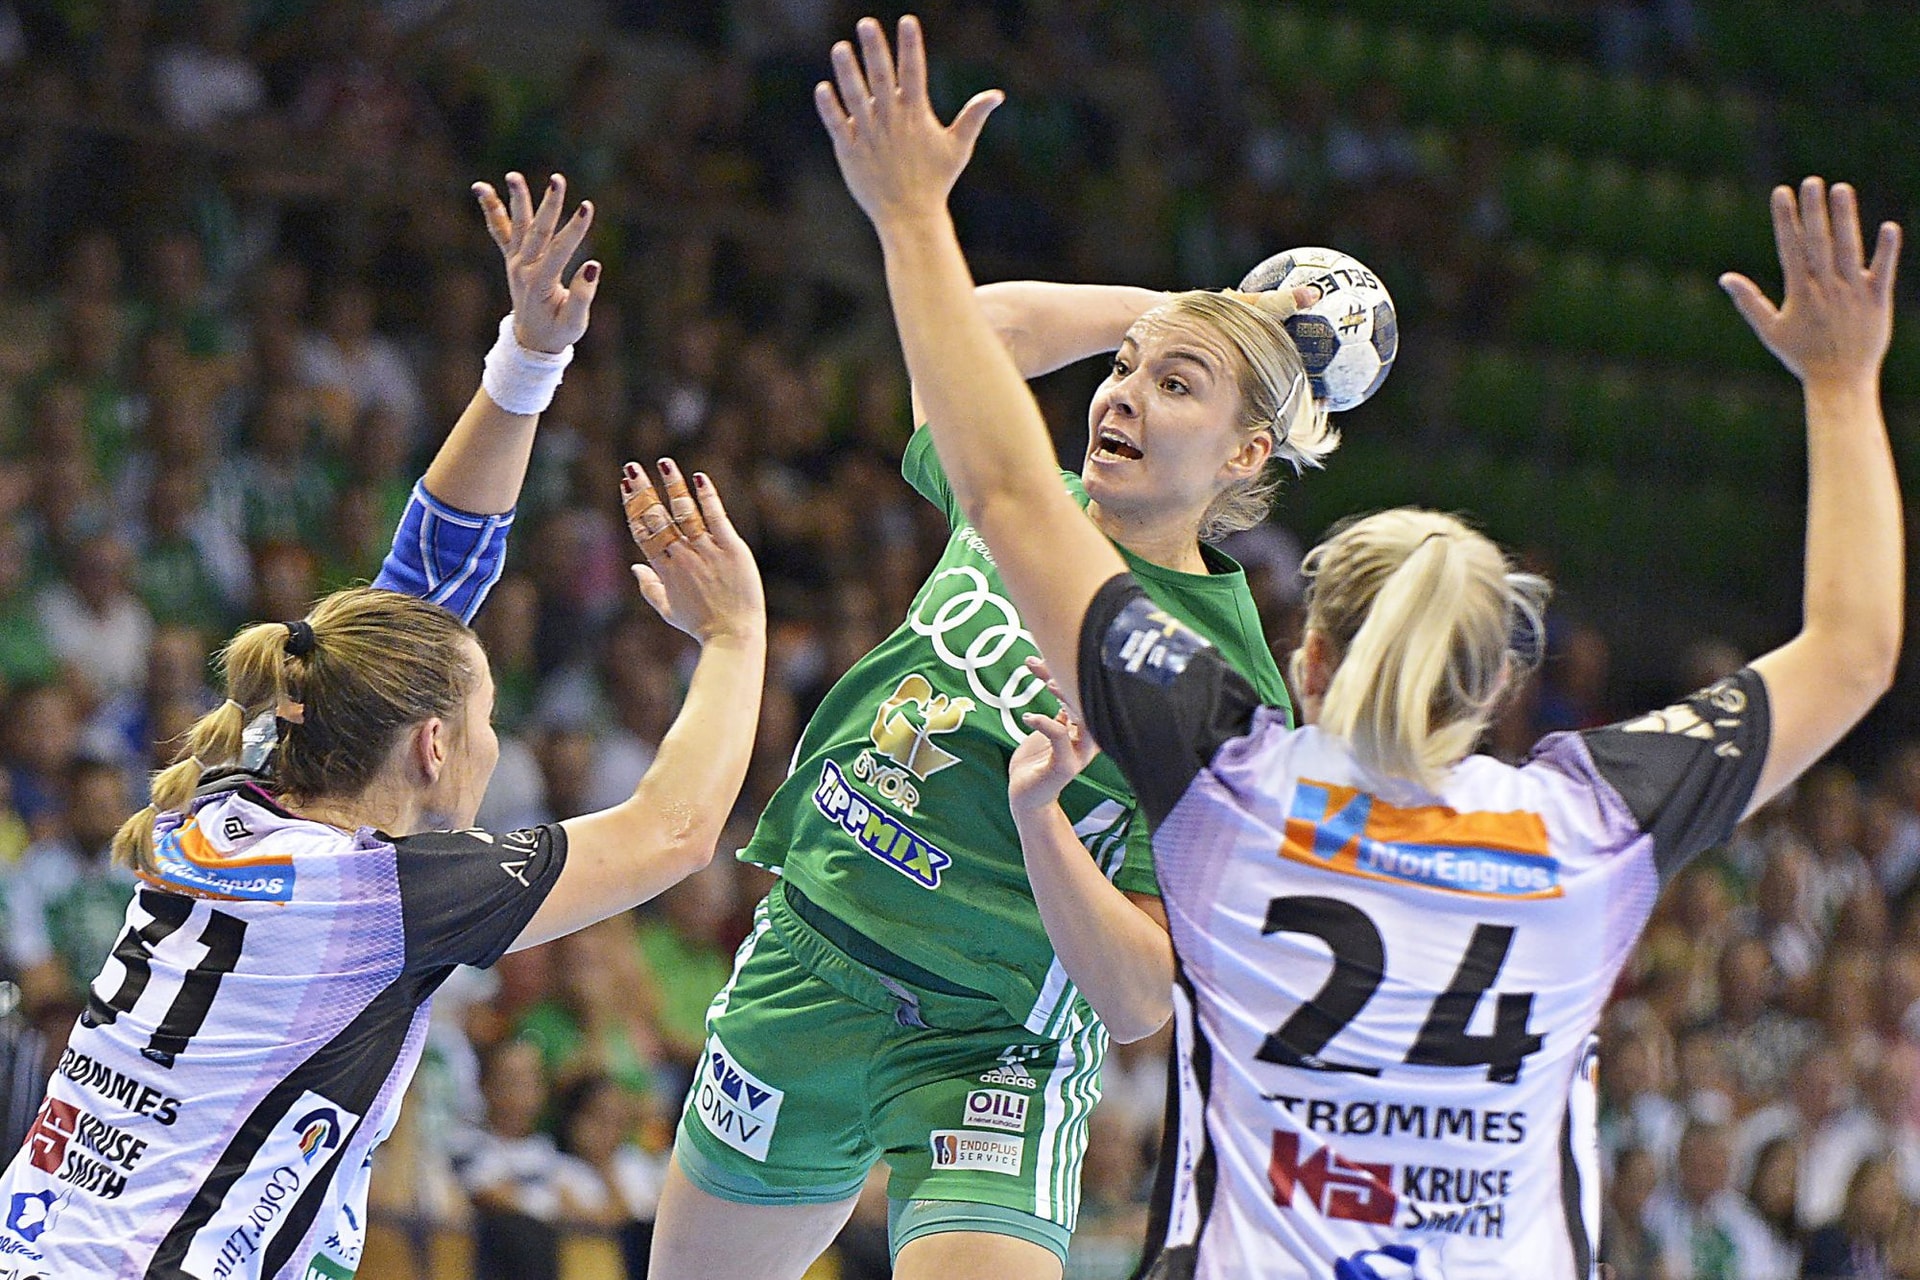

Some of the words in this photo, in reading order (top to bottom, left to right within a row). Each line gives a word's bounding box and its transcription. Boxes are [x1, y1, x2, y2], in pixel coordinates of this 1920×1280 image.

[1370, 841, 1551, 892] NorEngros
[80, 888, 249, 1071] 31
[1254, 895, 1546, 1086] 24
[969, 1091, 1025, 1120] OIL!
[979, 1073, 1037, 1090] adidas
[702, 1084, 762, 1143] OMV
[1259, 1092, 1528, 1144] TRØMMES
[74, 1112, 149, 1171] KRUSE
[959, 1152, 1017, 1167] SERVICE
[58, 1149, 129, 1200] SMITH
[1403, 1164, 1513, 1204] KRUSE
[1403, 1202, 1506, 1239] SMITH
